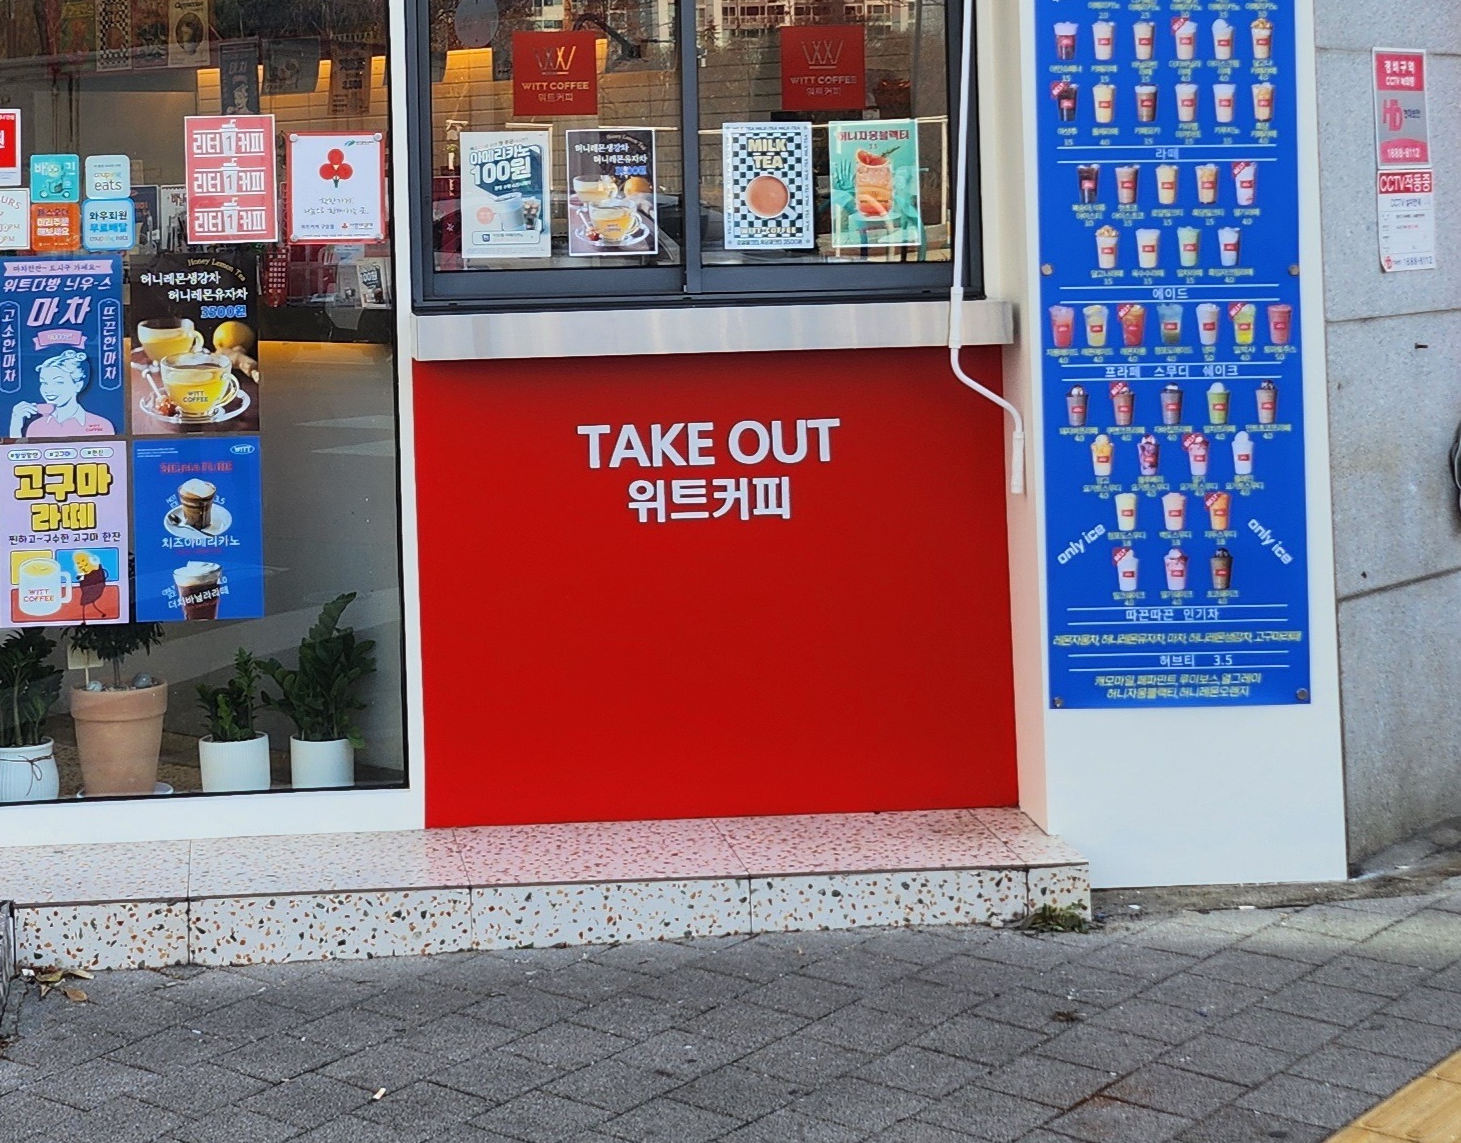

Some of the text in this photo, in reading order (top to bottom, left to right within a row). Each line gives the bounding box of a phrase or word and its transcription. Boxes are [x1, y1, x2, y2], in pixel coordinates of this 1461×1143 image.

[522, 81, 590, 90] WITT COFFEE
[790, 75, 858, 84] WITT COFFEE
[747, 138, 787, 153] MILK
[469, 144, 531, 164] 아메리카노
[1155, 148, 1179, 160] 라떼
[752, 155, 785, 169] TEA
[470, 156, 532, 185] 100원
[94, 179, 122, 191] eats
[89, 222, 128, 234] 무료배달
[187, 258, 211, 267] Honey
[211, 258, 234, 273] Lemon
[3, 277, 61, 293] 위트다방
[140, 271, 221, 286] 허니레몬생강차
[167, 287, 249, 303] 허니레몬유자차
[1152, 288, 1189, 300] 에이드
[26, 296, 92, 327] 마차
[200, 304, 248, 318] 3500원
[1153, 365, 1189, 378] 스무디
[234, 445, 251, 454] WITT
[577, 418, 841, 469] TAKE OUT
[13, 462, 114, 501] 고구마
[628, 476, 791, 523] 위트커피
[30, 502, 97, 532] 라떼
[73, 533, 99, 543] 고구마
[102, 531, 121, 542] 한잔
[161, 534, 240, 549] 치즈아메리카노
[1057, 539, 1085, 565] only
[1081, 523, 1106, 544] ice
[1247, 518, 1275, 547] only
[1271, 540, 1293, 565] ice
[23, 595, 55, 603] COFFEE
[1126, 608, 1219, 621] 따끈따끈 인기차
[1159, 654, 1233, 667] 허브티 3.5
